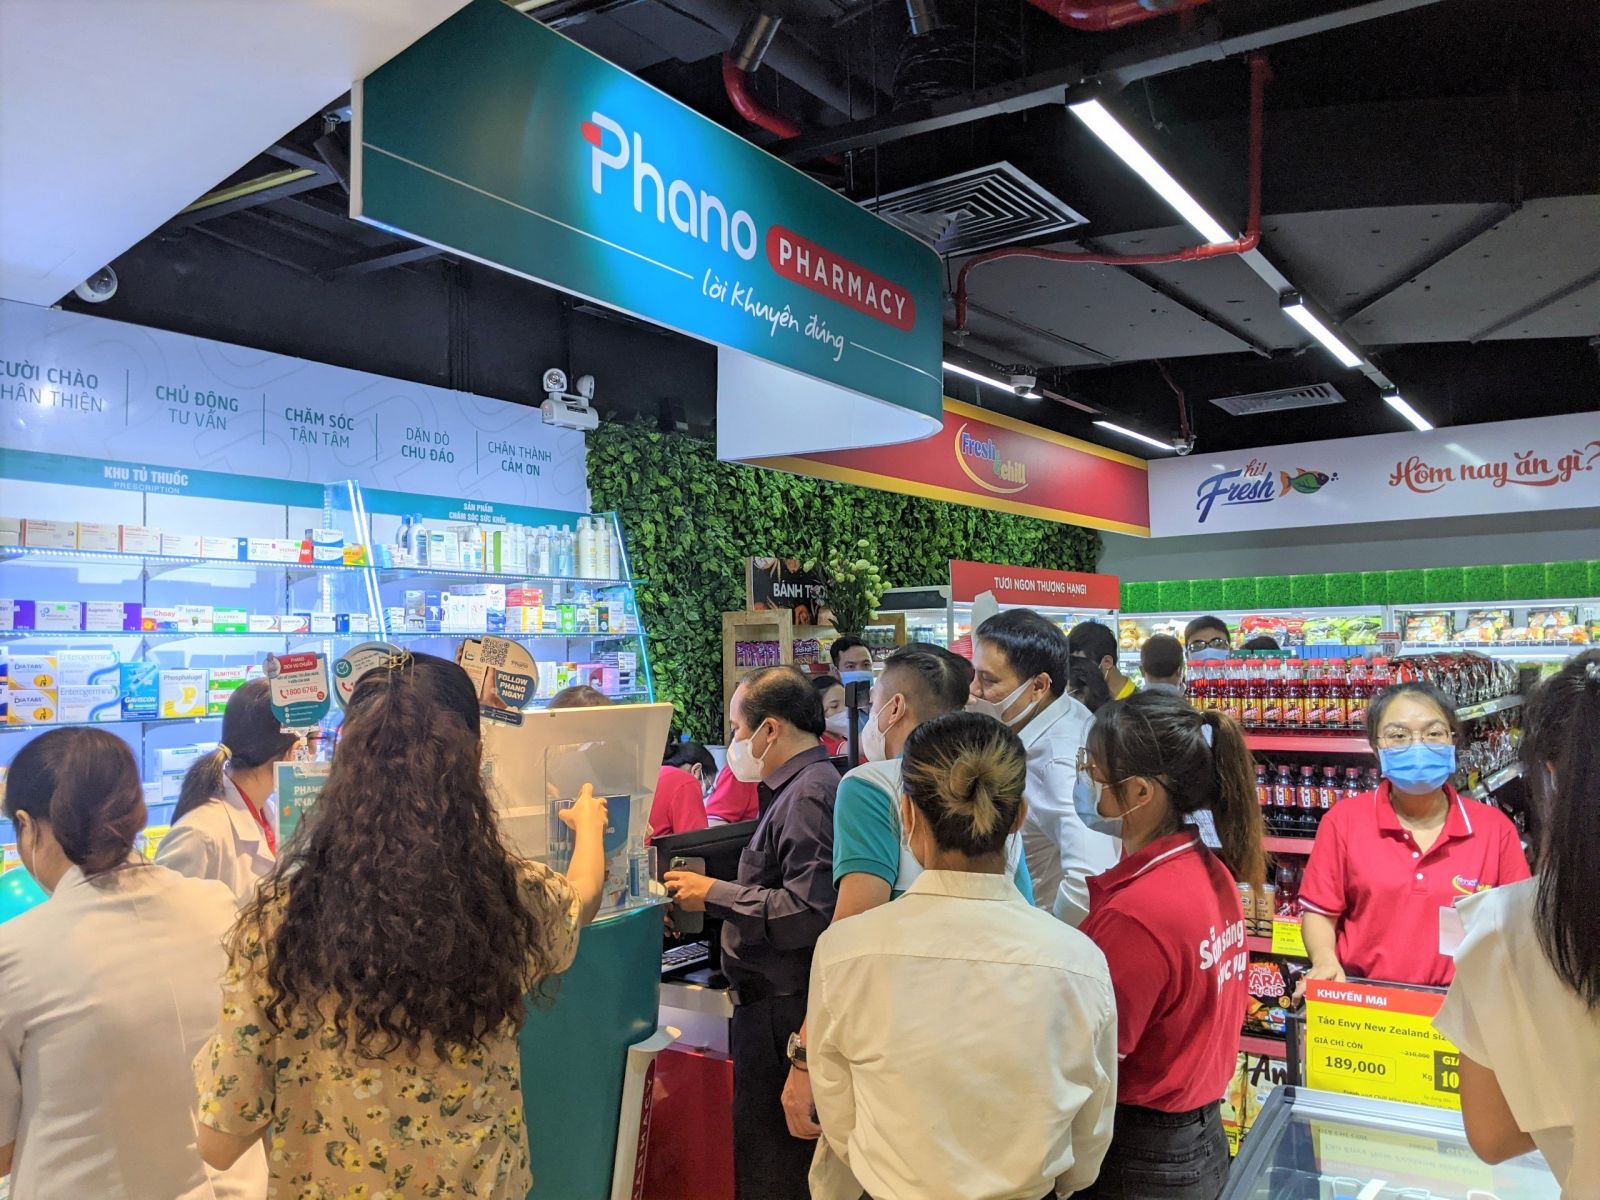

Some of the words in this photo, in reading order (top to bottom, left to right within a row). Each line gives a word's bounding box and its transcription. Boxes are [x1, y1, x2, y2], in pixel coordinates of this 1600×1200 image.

[581, 111, 758, 261] Phano
[778, 237, 906, 323] PHARMACY
[702, 268, 728, 299] lời
[804, 313, 846, 362] đúng
[47, 368, 99, 390] CHÀO
[50, 390, 103, 413] THIỆN
[155, 384, 190, 404] CHỦ
[194, 390, 239, 412] ĐỘNG
[168, 408, 191, 425] TƯ
[194, 409, 227, 431] VẤN
[284, 407, 325, 427] CHĂM
[329, 413, 355, 431] SÓC
[290, 427, 318, 446] TẬN
[322, 430, 350, 449] TÂM
[405, 426, 430, 445] DẶN
[433, 430, 450, 446] DÒ
[401, 444, 426, 460] CHU
[429, 445, 455, 464] ĐÁO
[487, 440, 517, 457] CHÂN
[518, 443, 552, 463] THÀNH
[961, 431, 996, 461] Fresh
[1001, 459, 1026, 485] chill
[103, 465, 130, 480] KHU
[132, 465, 149, 482] TỦ
[151, 467, 189, 487] THUỐC
[501, 457, 523, 475] CẢM
[525, 461, 541, 477] ƠN
[1243, 457, 1268, 478] hi!
[1388, 455, 1457, 494] Hôm
[1460, 460, 1510, 488] nay
[1513, 450, 1554, 477] ăn
[1556, 440, 1600, 483] gì?
[113, 481, 181, 494] PRESCRIPTION
[1196, 468, 1276, 524] Fresh
[773, 580, 803, 598] BÁNH
[993, 575, 1013, 589] TƯƠI
[1014, 579, 1035, 591] NGON
[1036, 580, 1066, 596] THƯỢNG
[1066, 584, 1087, 598] HẠNG!
[153, 610, 176, 619] Choay
[163, 673, 203, 681] Phosphalugel
[497, 674, 528, 686] FOLLOW
[500, 682, 526, 692] PHANO
[60, 687, 112, 697] Enterogermina
[501, 689, 524, 701] NGAY!
[1221, 919, 1244, 953] sàng
[1316, 988, 1363, 1003] KHUYẾN
[1317, 1015, 1335, 1026] Táo
[1338, 1018, 1361, 1031] Envy
[1364, 1022, 1387, 1033] New
[1389, 1025, 1430, 1039] Zealand
[1324, 1055, 1387, 1076] 189,000
[1422, 1073, 1433, 1082] Kg
[1441, 1070, 1460, 1089] 10
